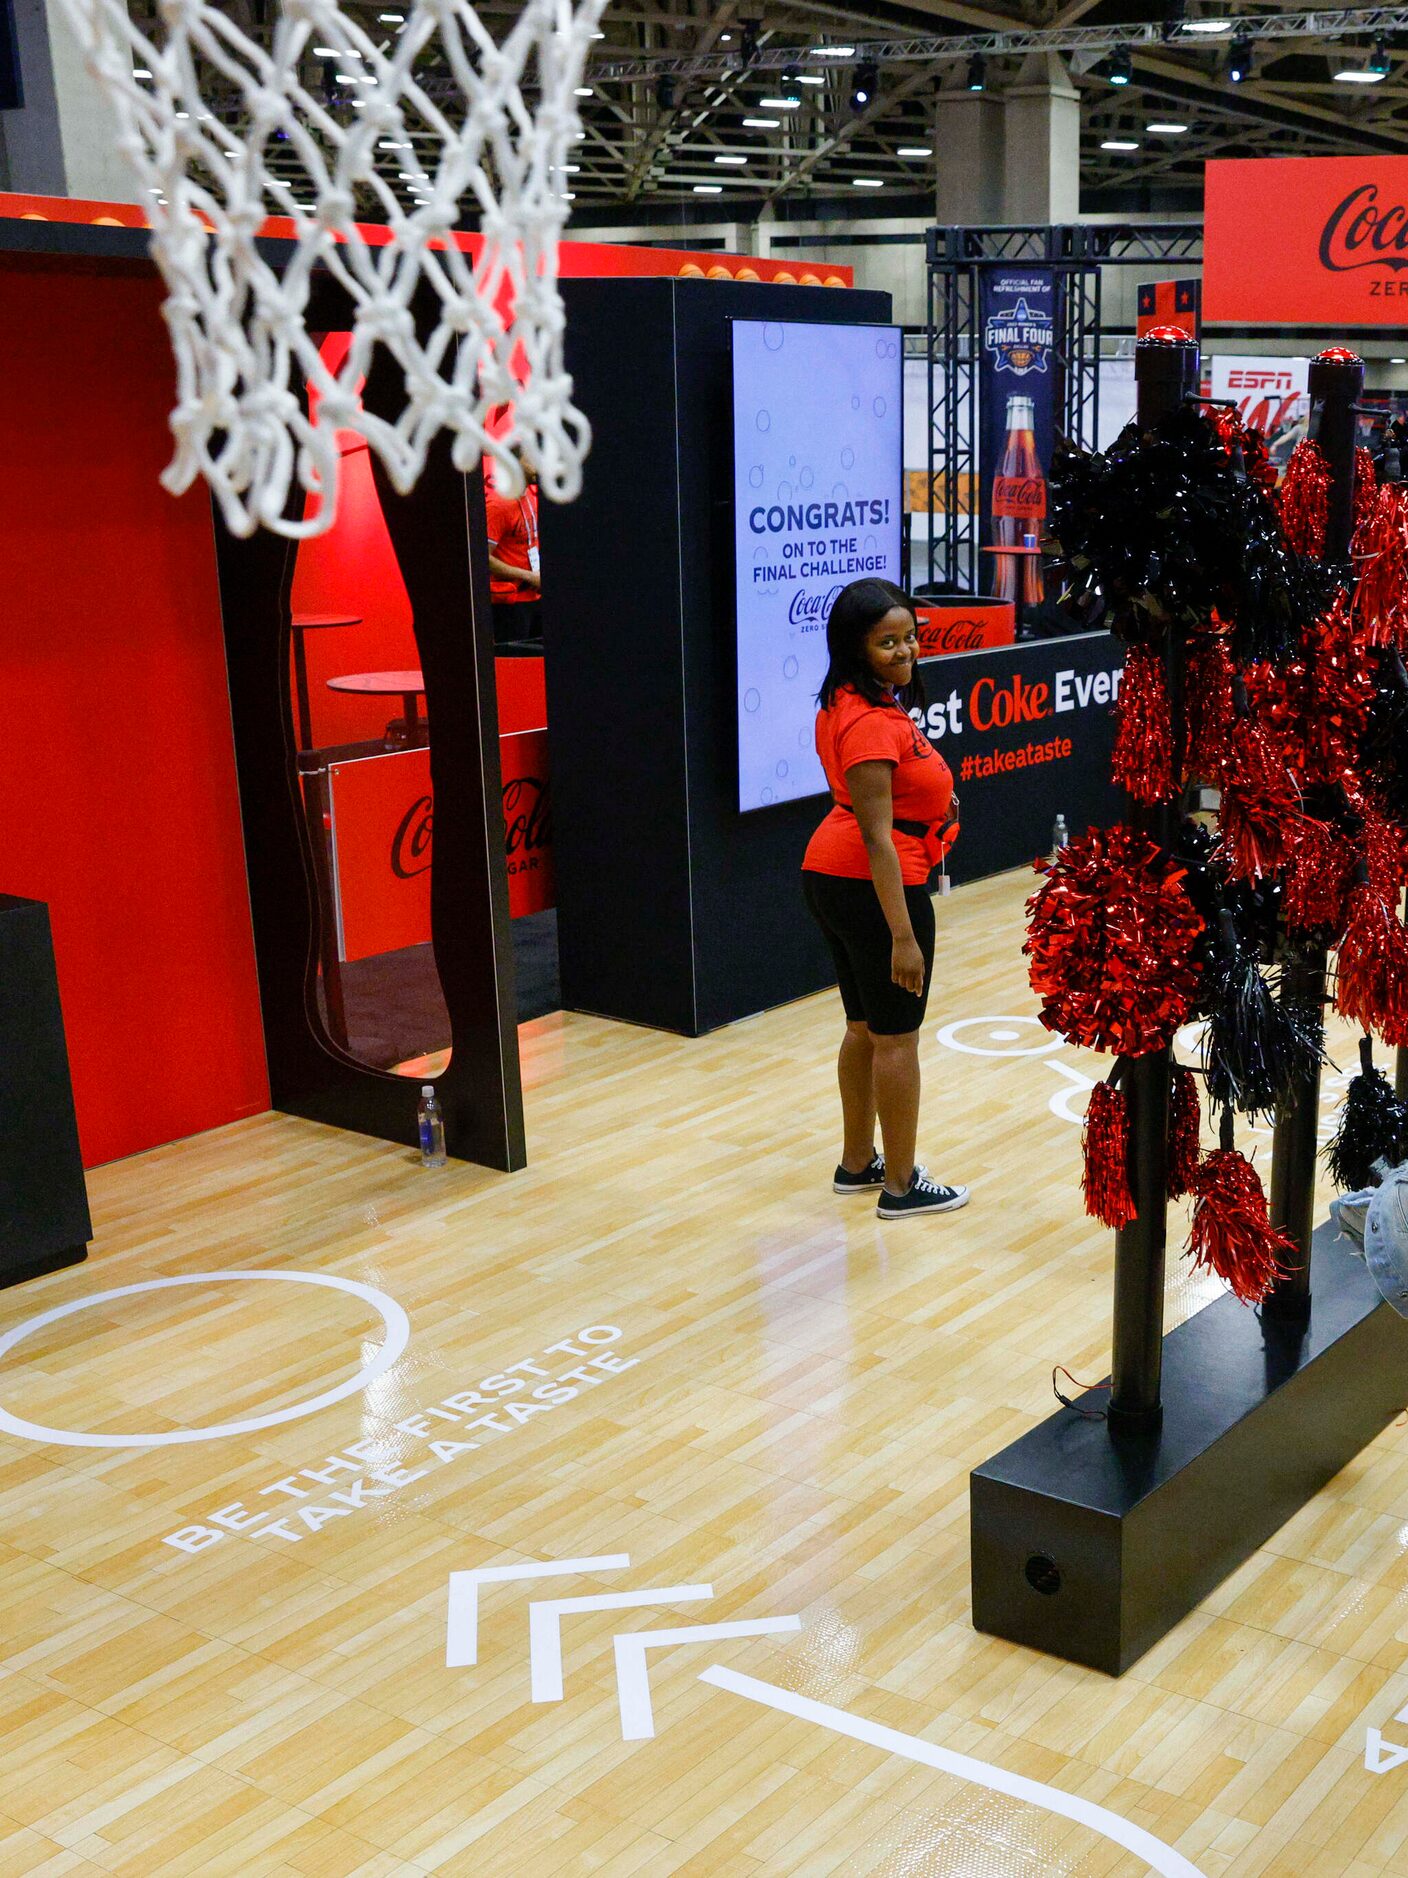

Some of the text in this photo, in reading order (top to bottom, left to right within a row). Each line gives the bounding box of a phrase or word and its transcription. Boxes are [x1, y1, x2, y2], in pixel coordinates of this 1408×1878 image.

[988, 327, 1053, 346] FINAL FOUR
[1228, 370, 1292, 389] ESPN
[749, 499, 890, 534] CONGRATS!
[782, 538, 857, 559] ON TO THE
[753, 555, 887, 583] FINAL CHALLENGE!
[788, 585, 846, 625] Coca-C
[969, 674, 1049, 731] Coke
[960, 735, 1072, 781] #takeataste
[507, 857, 540, 875] GAR
[162, 1325, 623, 1553] BE THE FIRST TO
[250, 1351, 640, 1542] TAKE A TASTE
